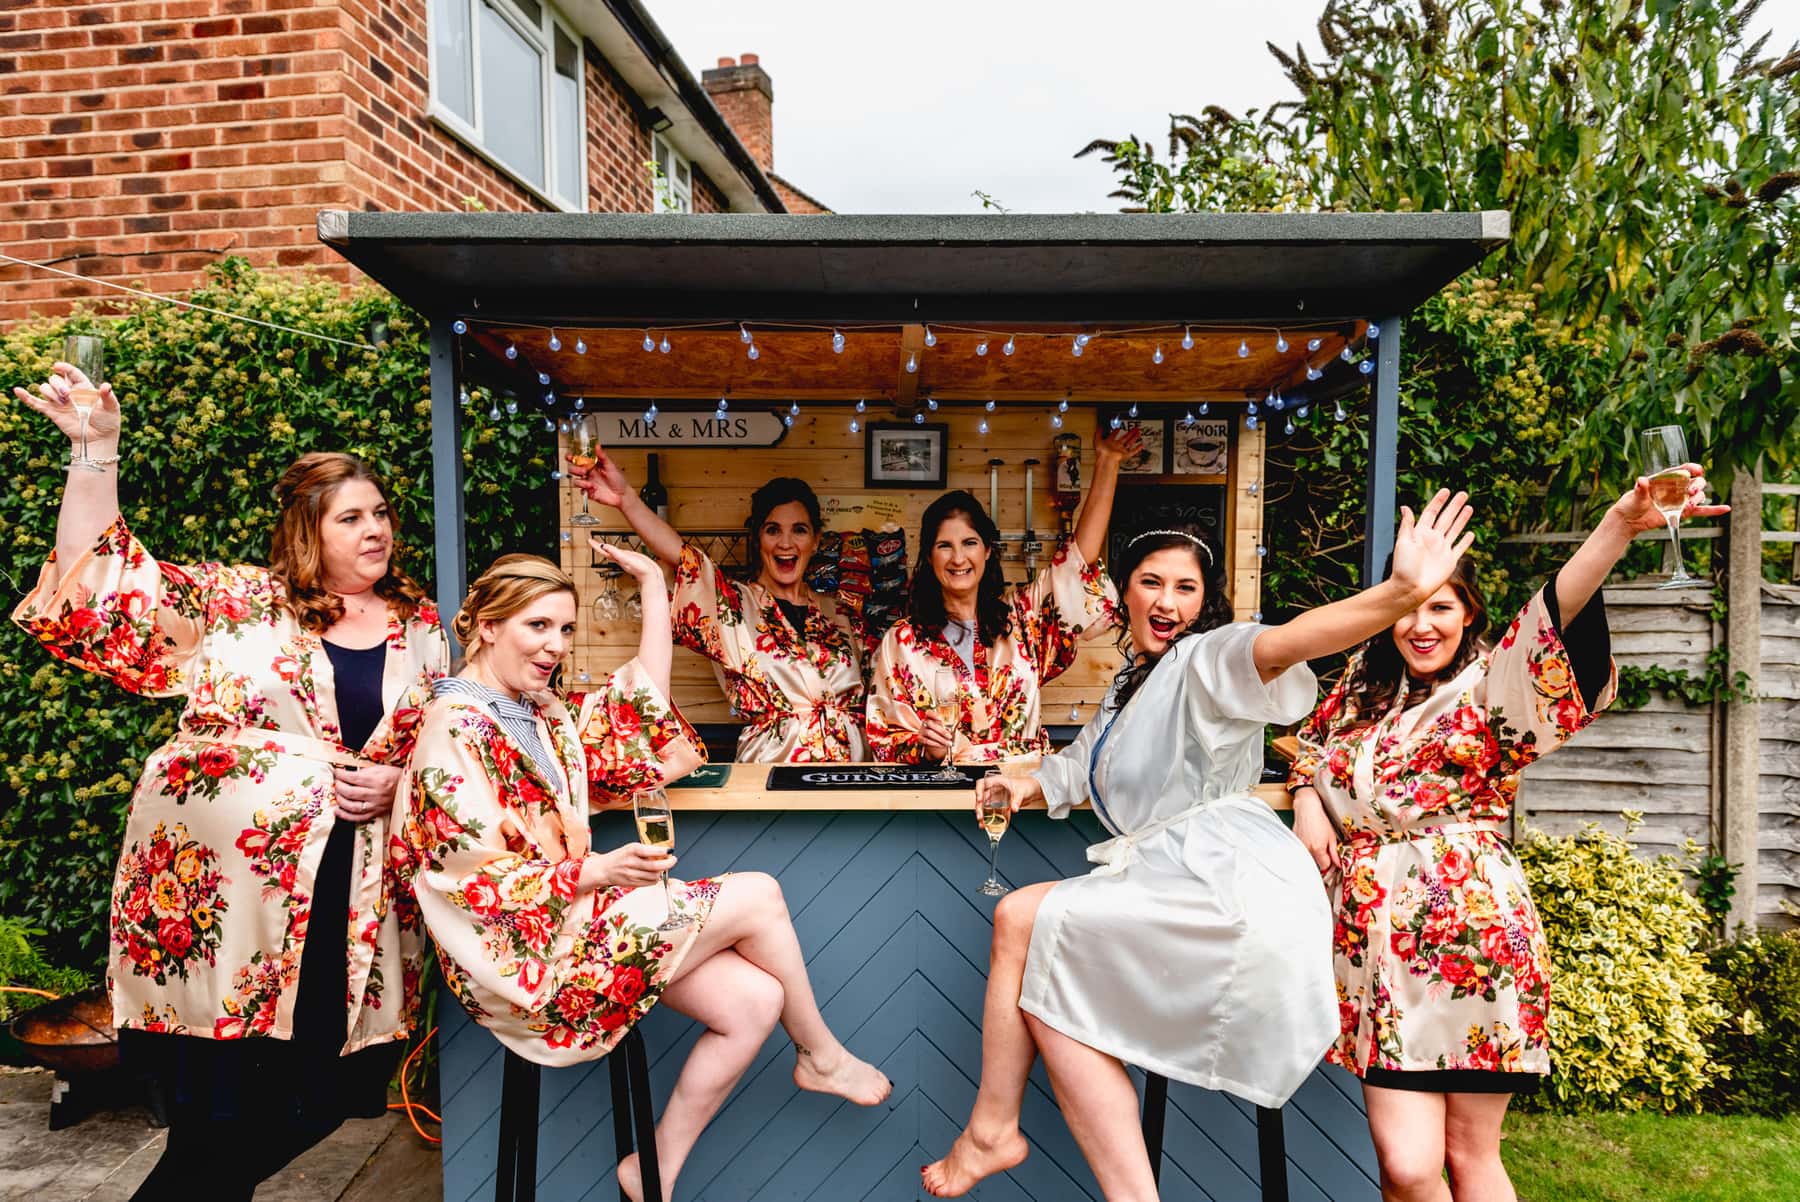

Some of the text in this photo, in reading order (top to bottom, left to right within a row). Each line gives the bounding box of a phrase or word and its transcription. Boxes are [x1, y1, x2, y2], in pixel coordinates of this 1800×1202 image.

[618, 418, 748, 438] MR & MRS
[801, 772, 973, 783] GUINNE
